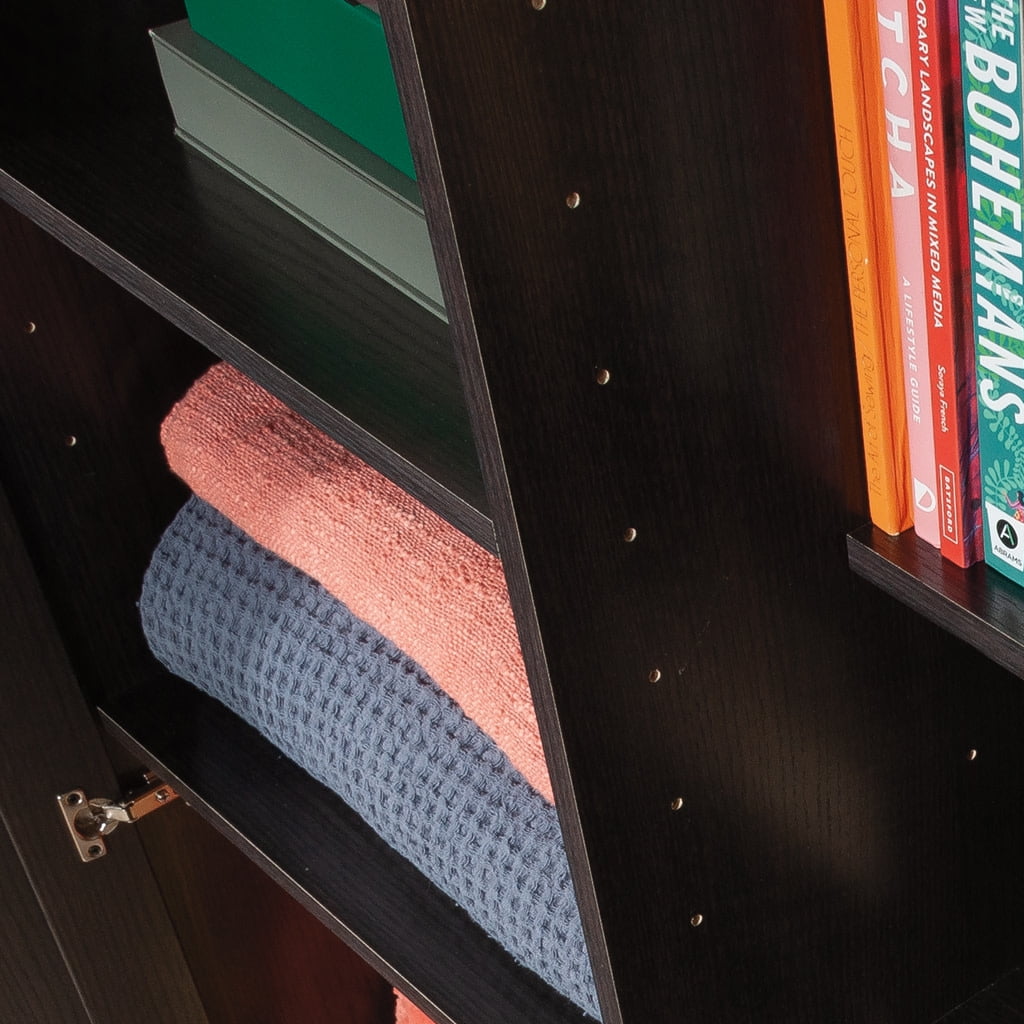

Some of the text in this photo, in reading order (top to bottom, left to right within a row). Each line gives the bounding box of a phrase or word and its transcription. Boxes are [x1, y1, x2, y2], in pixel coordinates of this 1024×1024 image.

[918, 69, 937, 190] LANDSCAPES
[839, 124, 858, 201] TOUCH
[926, 192, 938, 213] IN
[845, 209, 867, 300] PERSONAL
[927, 215, 942, 273] MIXED
[930, 272, 944, 328] MEDIA
[902, 276, 921, 425] A LIFESTYLE GUIDE
[936, 365, 950, 433] Soraya French
[943, 475, 954, 534] BATSFORD
[993, 545, 1023, 567] ABRAMS
